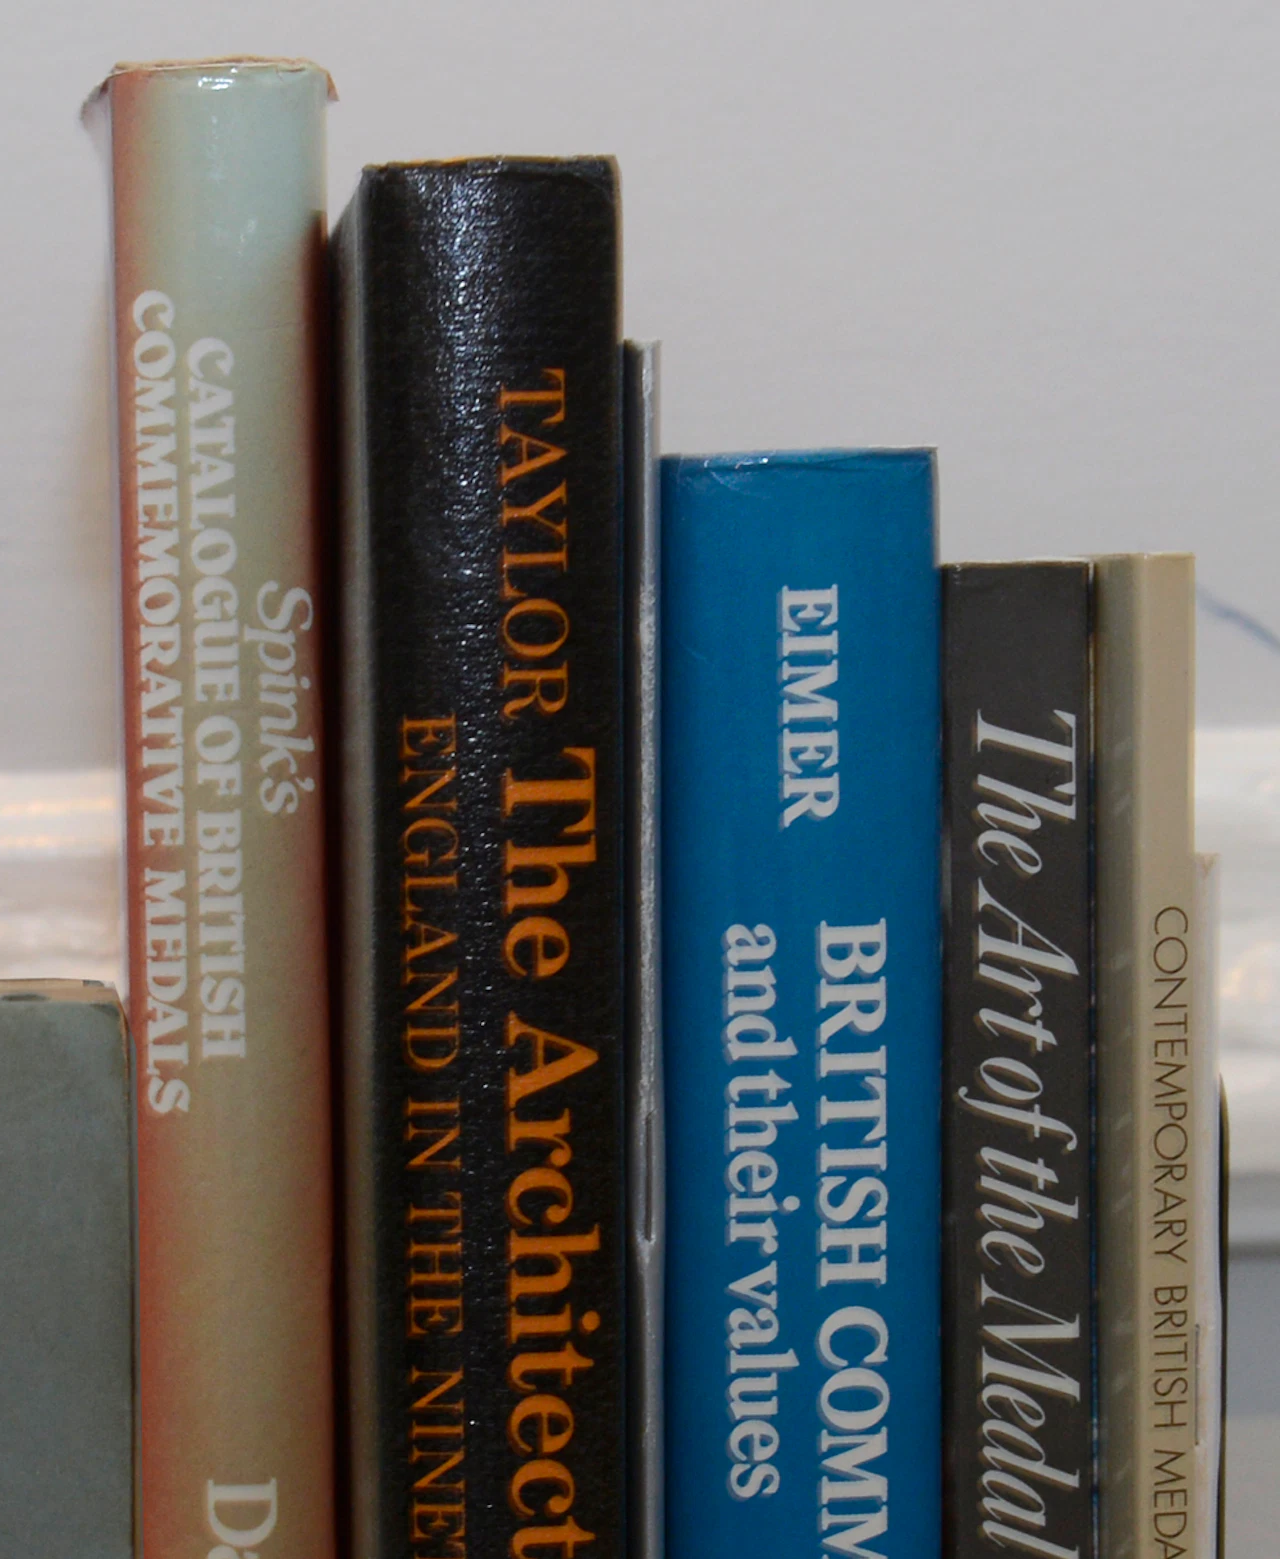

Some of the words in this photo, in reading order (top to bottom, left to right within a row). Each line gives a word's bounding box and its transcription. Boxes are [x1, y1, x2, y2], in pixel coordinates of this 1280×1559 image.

[131, 289, 185, 848] COMMEMORATIVE
[186, 338, 241, 706] CATALOGUE
[499, 367, 569, 719] TAYLOR
[195, 713, 243, 801] OF
[256, 579, 315, 818] Spink's
[778, 584, 840, 828] EIMER
[976, 707, 1078, 876] The
[196, 806, 247, 1060] BRITISH
[402, 713, 459, 1073] ENGLAND
[502, 746, 598, 979] The
[973, 878, 1080, 1056] Art
[142, 868, 190, 1117] MEDALS
[723, 922, 798, 1063] and
[816, 918, 889, 1288] BRITISH
[958, 1055, 1078, 1155] of
[1152, 905, 1189, 1260] CONTEMPORARY
[403, 1098, 461, 1172] IN
[724, 1068, 800, 1257] their
[975, 1143, 1080, 1277] the
[407, 1190, 464, 1338] THE
[725, 1259, 800, 1502] values
[1153, 1284, 1188, 1432] BRITISH
